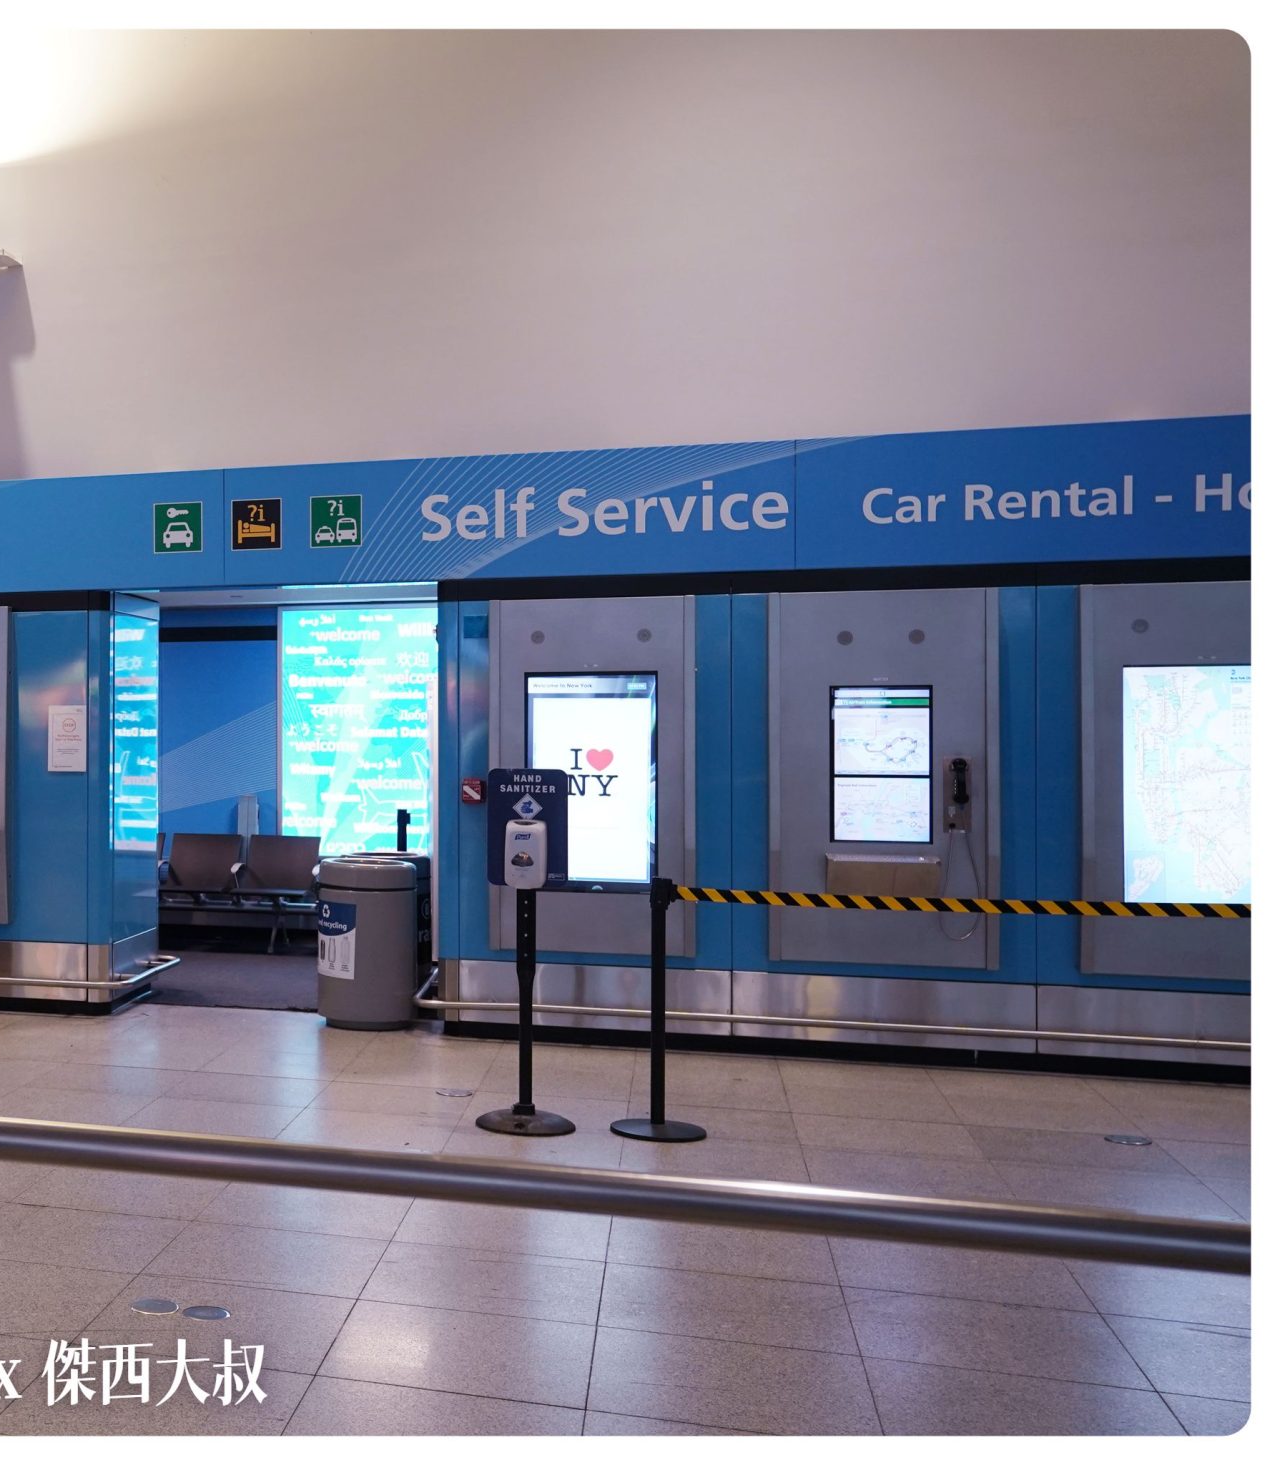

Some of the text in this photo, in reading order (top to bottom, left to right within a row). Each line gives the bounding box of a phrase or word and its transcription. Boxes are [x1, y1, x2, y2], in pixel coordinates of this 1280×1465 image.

[421, 480, 789, 541] Self Service
[862, 487, 946, 525] Car
[964, 474, 1133, 521] Rental
[1155, 495, 1173, 504] -
[570, 748, 583, 770] I
[500, 784, 556, 794] SANITIZER
[513, 774, 542, 783] HAND
[568, 774, 618, 796] NY
